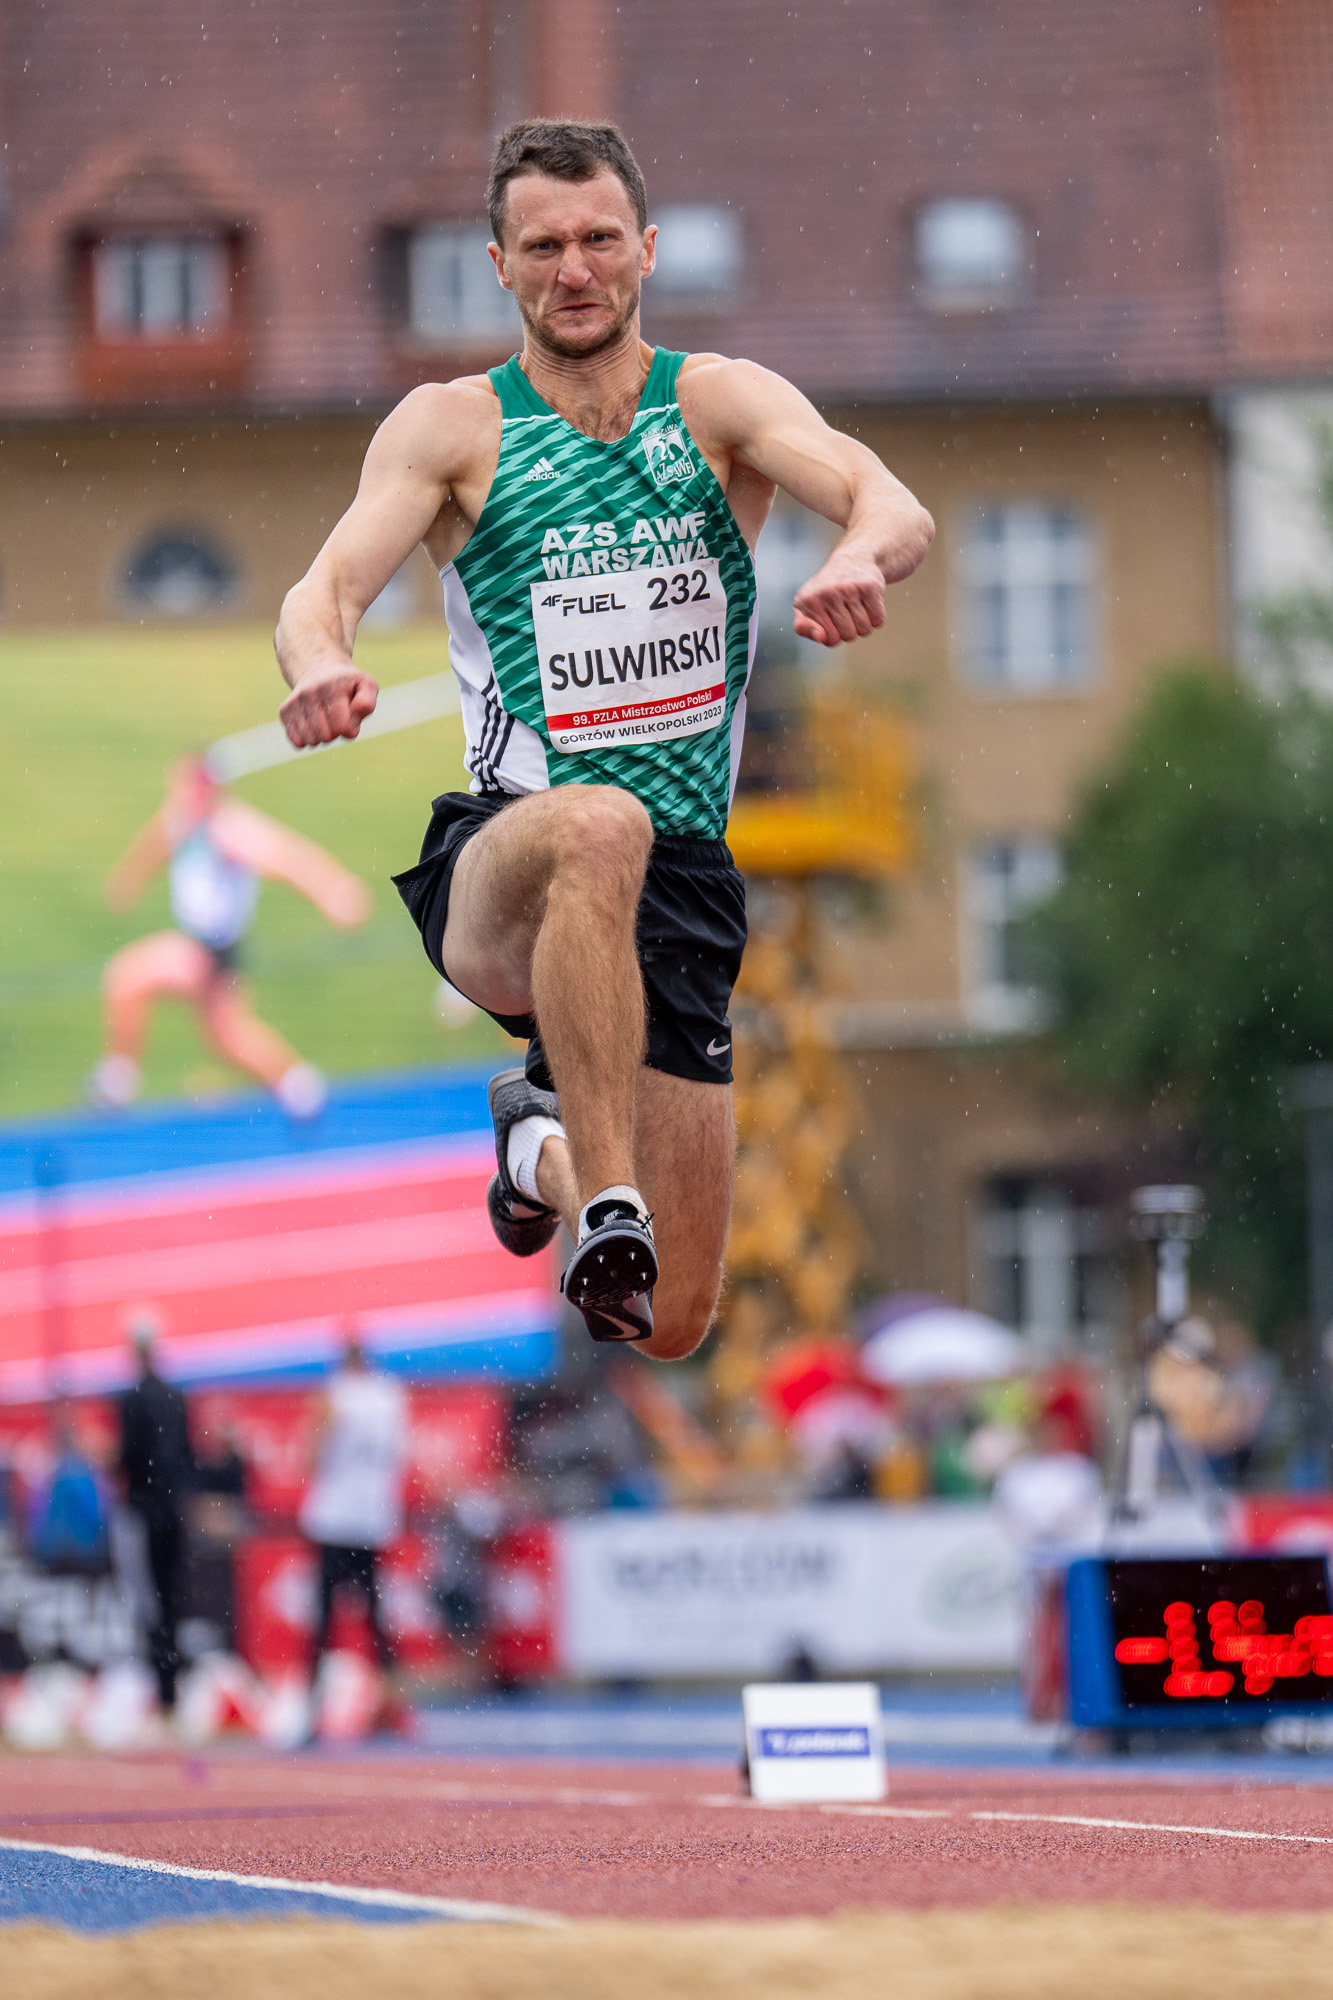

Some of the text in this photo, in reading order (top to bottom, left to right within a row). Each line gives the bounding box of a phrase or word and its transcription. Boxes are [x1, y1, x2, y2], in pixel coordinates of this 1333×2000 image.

[524, 470, 561, 482] adidas
[540, 511, 706, 554] AZS AWF
[541, 537, 709, 580] WARSZAWA
[562, 593, 626, 617] FUEL
[647, 569, 711, 611] 232
[548, 625, 721, 691] SULWIRSKI
[559, 705, 722, 745] GORZÓW WIELKOPOLSKI 2023
[572, 690, 712, 726] 99. PZLA Mistrzostwa Polski
